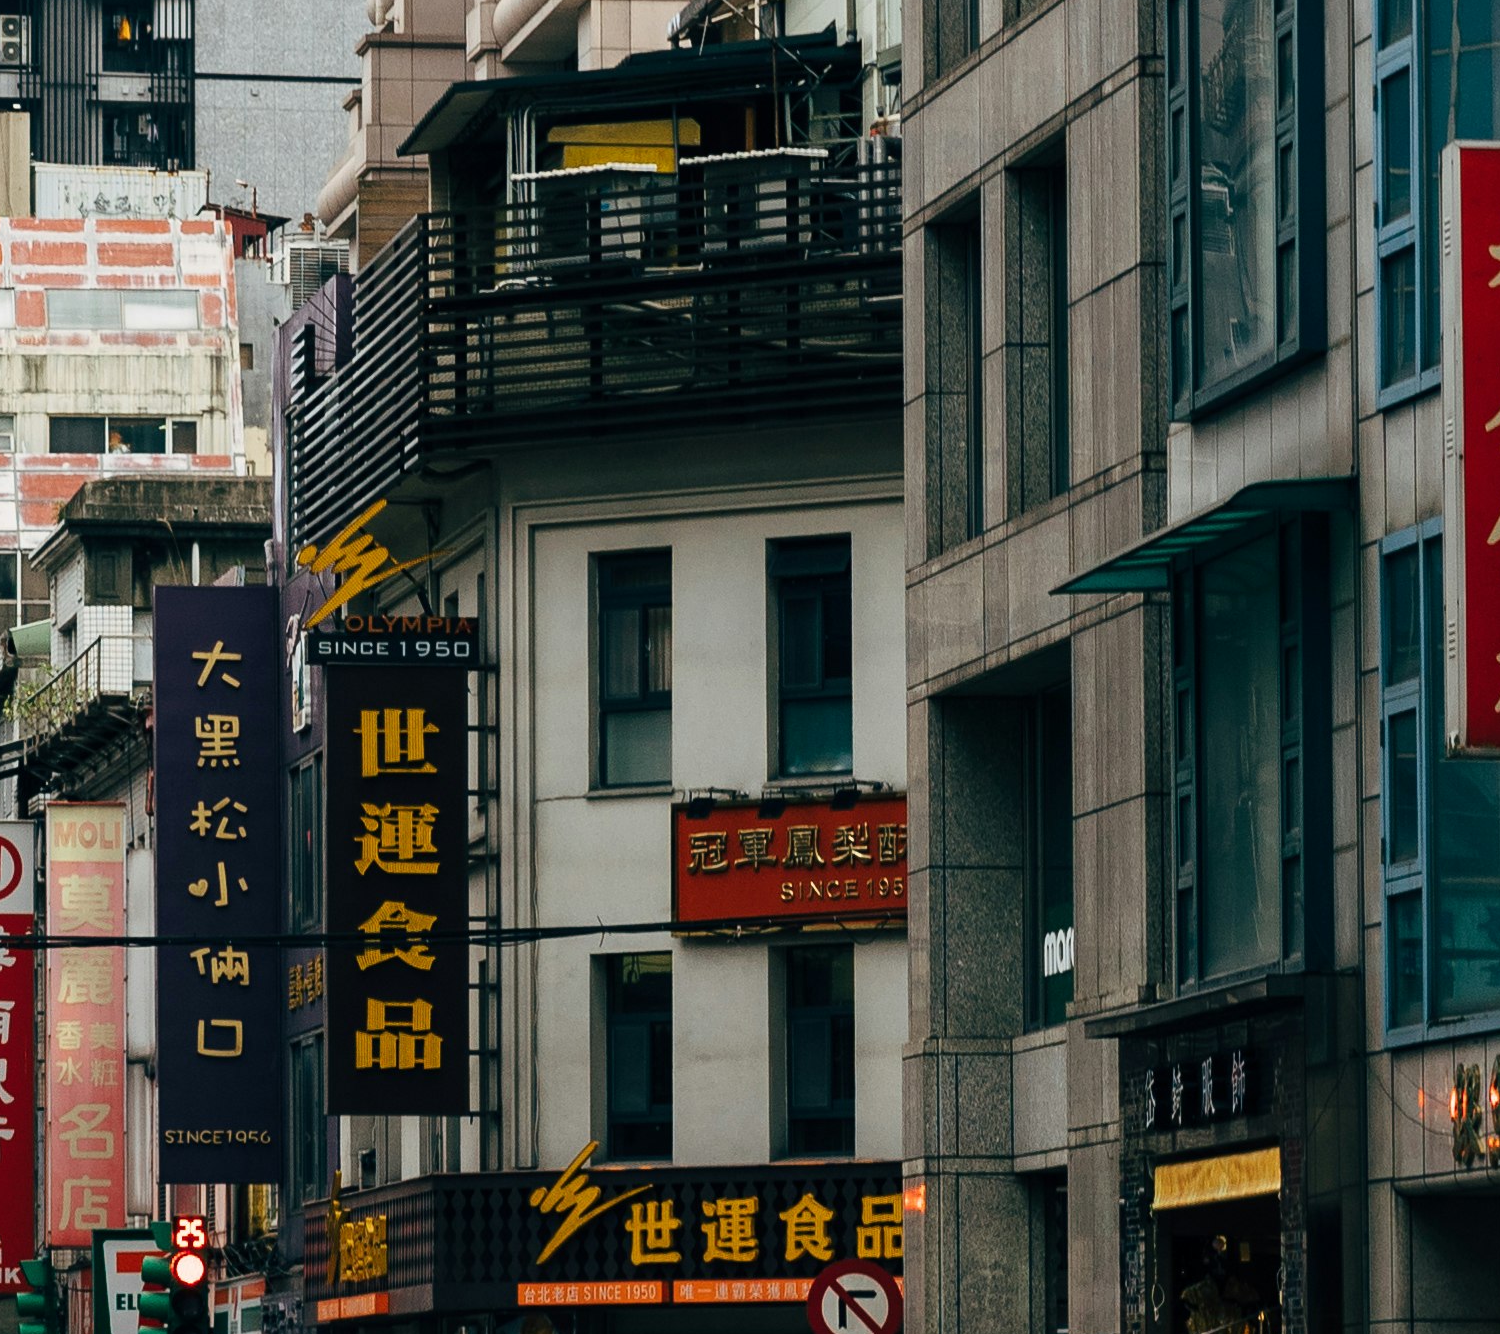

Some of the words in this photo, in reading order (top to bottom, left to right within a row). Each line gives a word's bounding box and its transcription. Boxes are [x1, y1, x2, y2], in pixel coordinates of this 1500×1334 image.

[346, 616, 472, 634] OLYMPIA
[318, 640, 390, 656] SINCE
[399, 640, 470, 657] 1950
[54, 820, 121, 850] MOLI
[188, 638, 252, 1059] 大黑松小倆口
[353, 707, 443, 1070] 世運食品
[780, 879, 860, 901] SINCE
[176, 1219, 205, 1248] 25
[625, 1193, 905, 1266] 世運食品
[584, 1287, 621, 1301] SINCE
[626, 1284, 656, 1300] 1950
